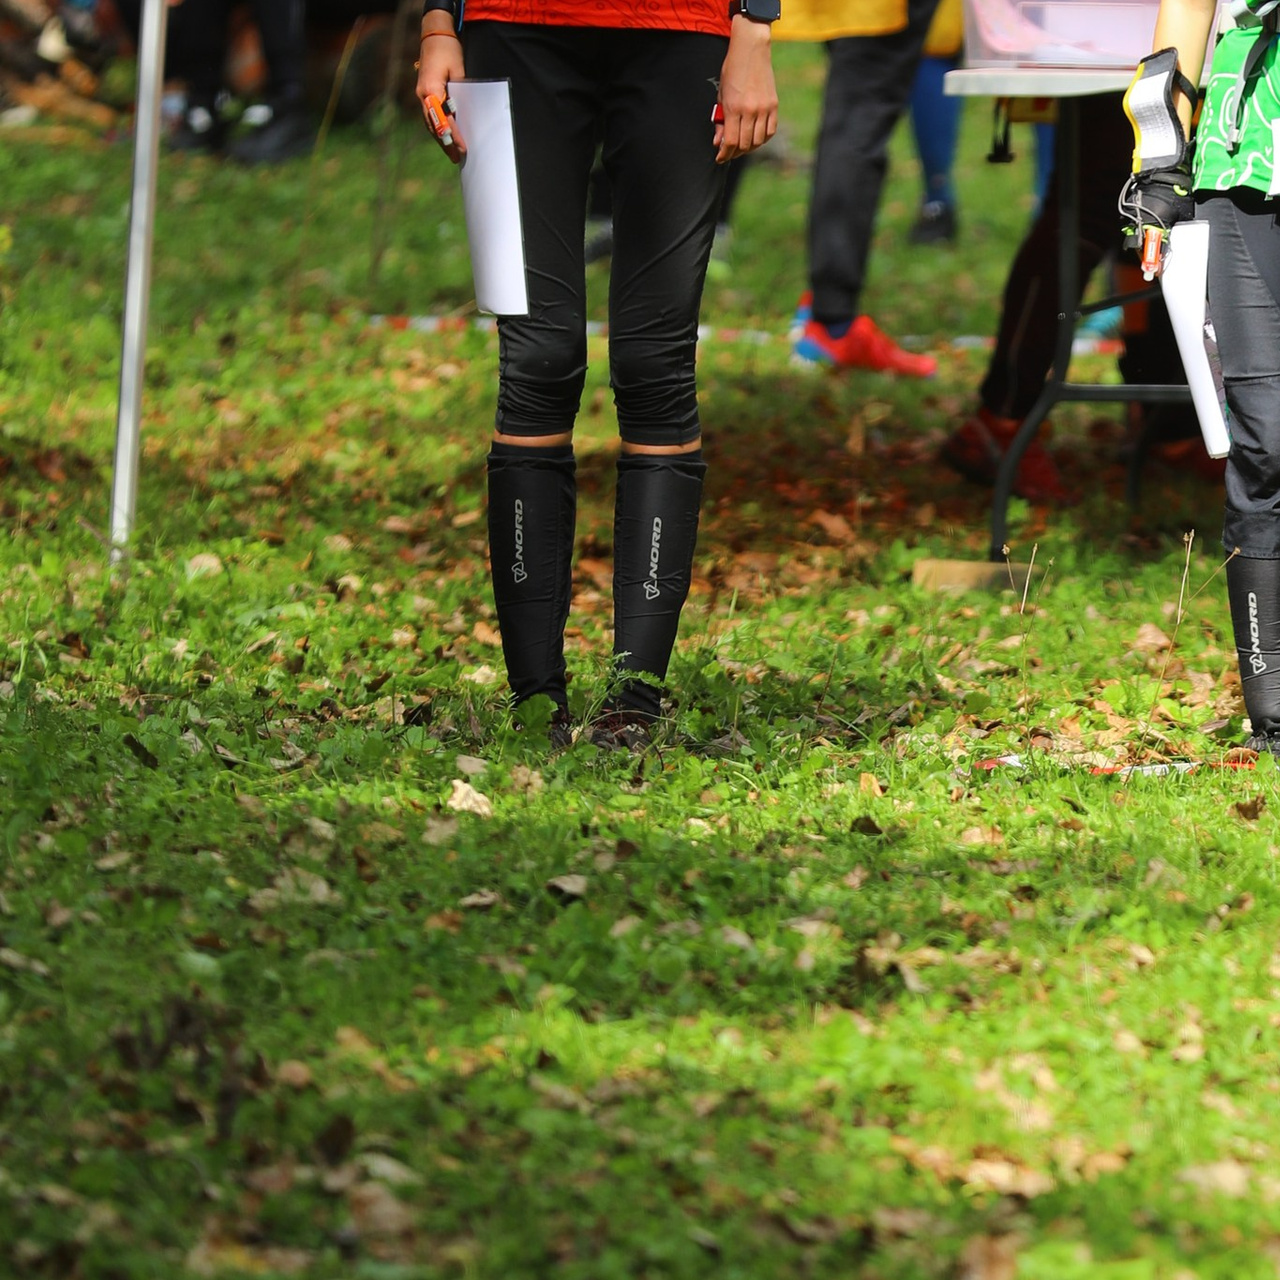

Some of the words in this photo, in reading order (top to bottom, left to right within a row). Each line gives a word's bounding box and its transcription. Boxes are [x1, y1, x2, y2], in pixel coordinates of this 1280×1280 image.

[514, 499, 523, 560] NORD
[649, 516, 662, 579] NORD
[1248, 592, 1260, 654] NORD
